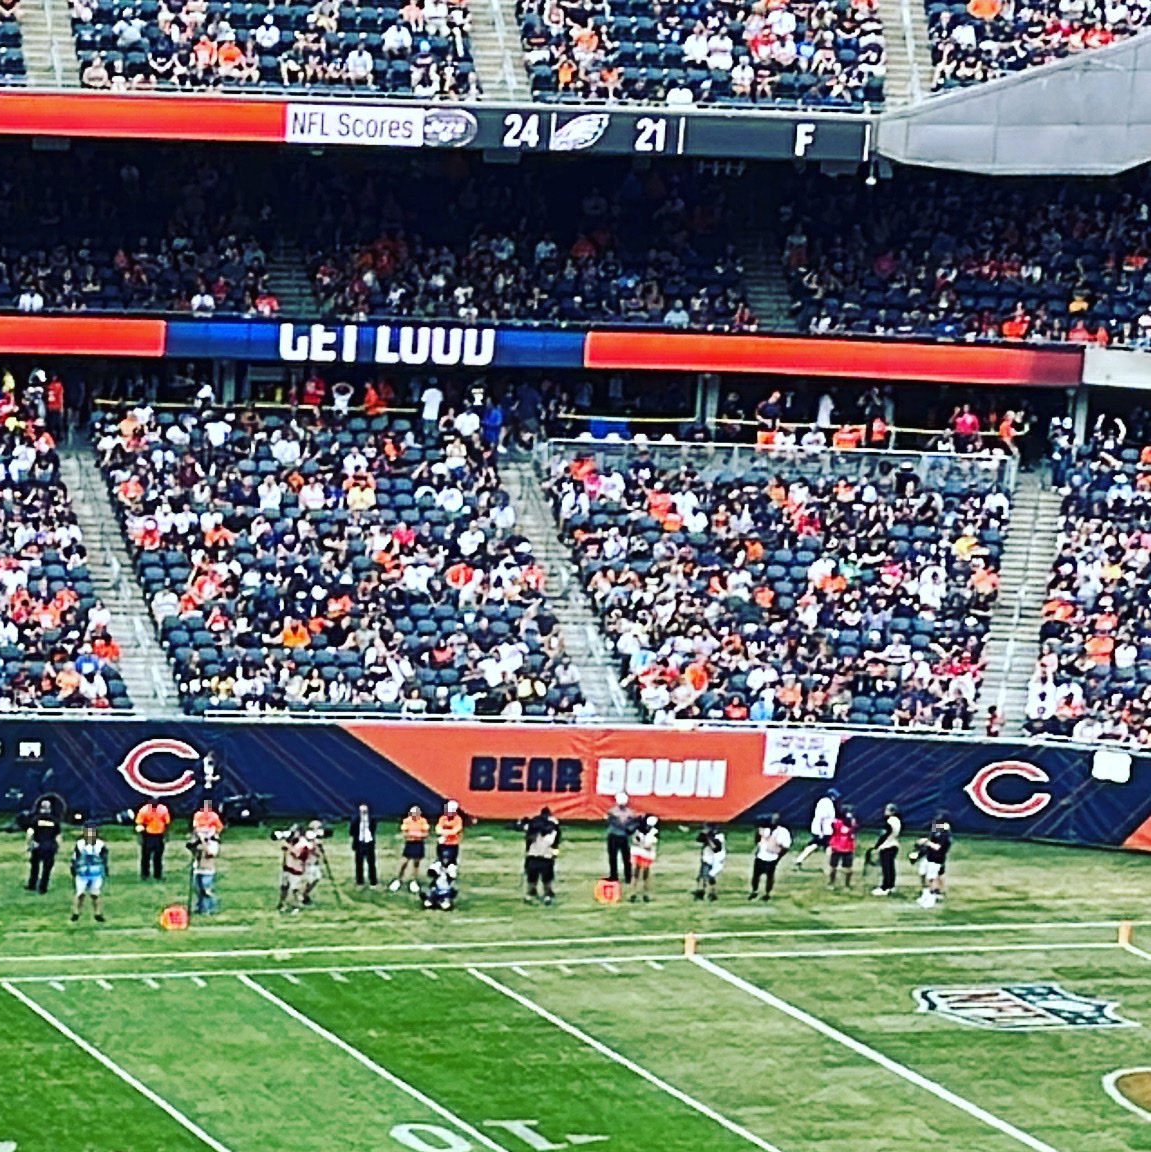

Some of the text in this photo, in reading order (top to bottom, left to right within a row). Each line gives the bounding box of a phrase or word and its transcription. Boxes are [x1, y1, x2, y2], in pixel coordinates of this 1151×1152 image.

[292, 111, 329, 137] NFL
[337, 112, 414, 140] Scores
[503, 113, 540, 147] 24
[634, 117, 666, 152] 21
[794, 123, 815, 157] F
[468, 756, 728, 798] BEAR DOWN
